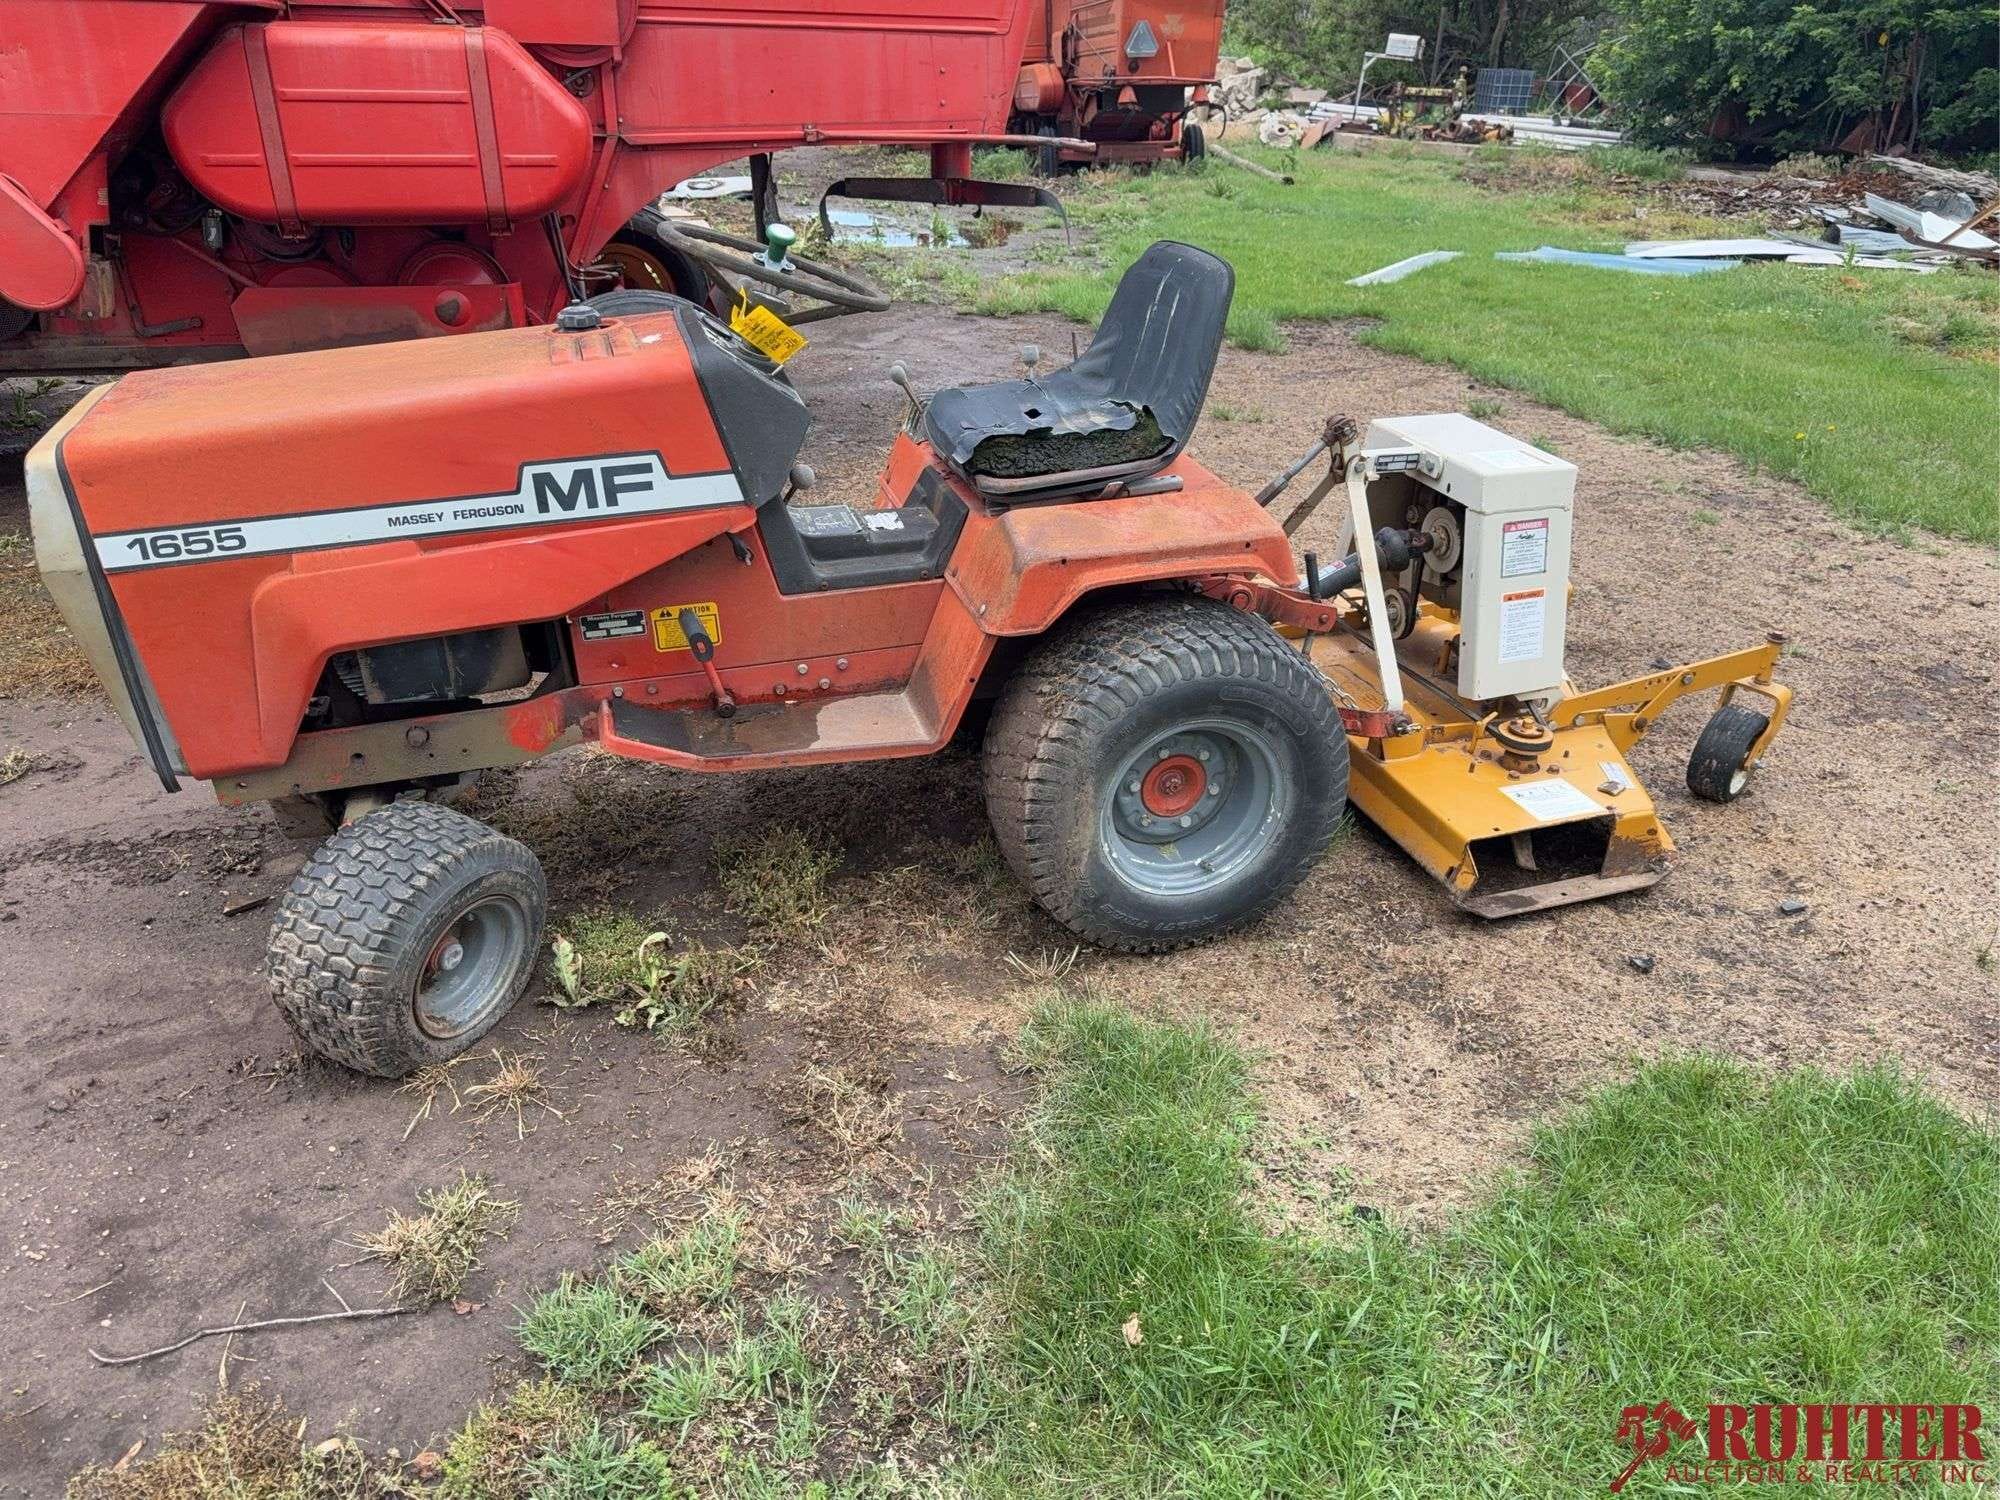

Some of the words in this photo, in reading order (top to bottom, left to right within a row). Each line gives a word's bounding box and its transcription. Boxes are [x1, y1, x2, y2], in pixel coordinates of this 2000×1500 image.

[532, 462, 654, 514] MF
[387, 511, 444, 528] MASSEY
[453, 504, 524, 521] FERGUSON
[126, 526, 247, 561] 1655
